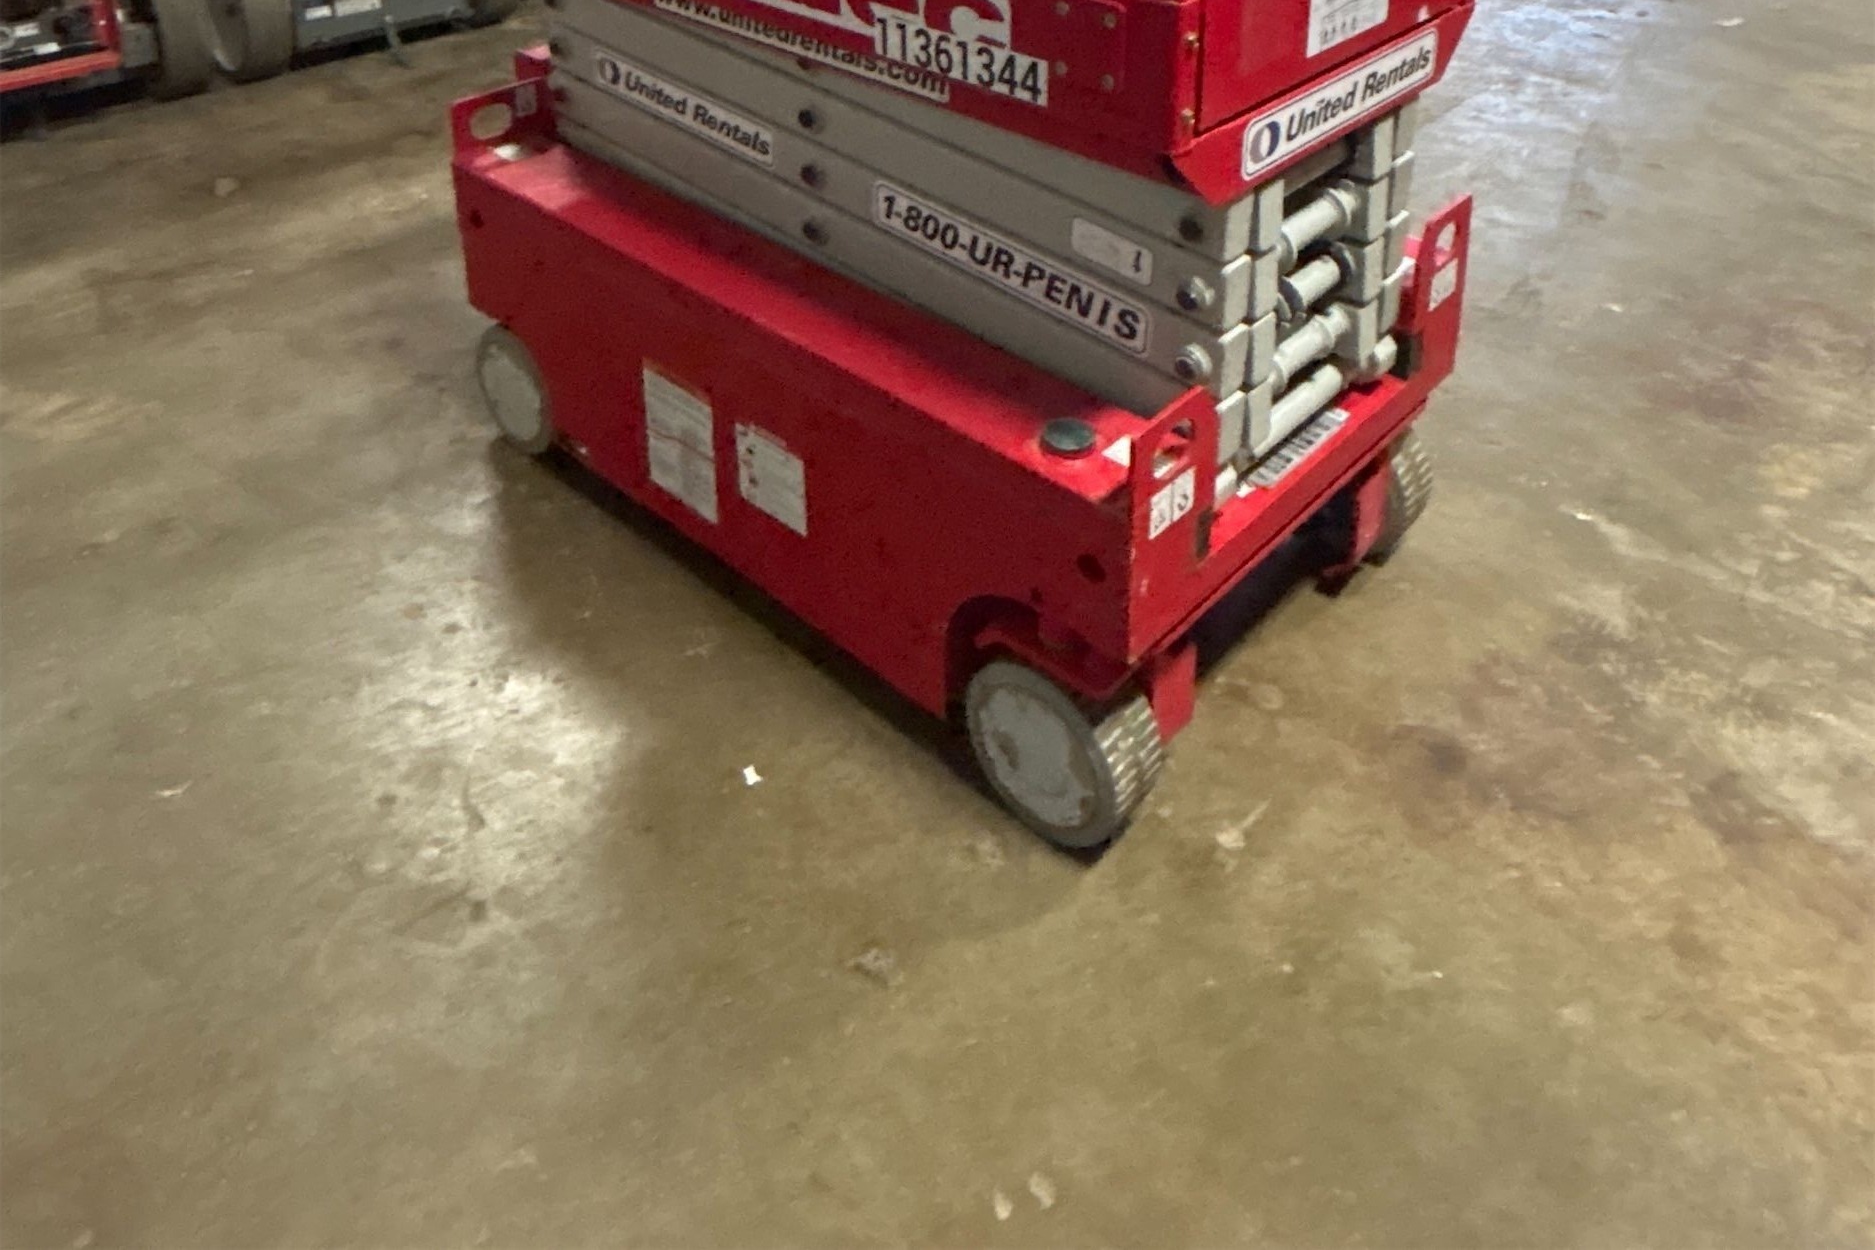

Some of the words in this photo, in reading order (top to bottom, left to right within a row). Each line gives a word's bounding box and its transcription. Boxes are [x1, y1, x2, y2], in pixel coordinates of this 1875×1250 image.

[876, 17, 1042, 102] 11361344
[1286, 82, 1359, 142] United
[1361, 46, 1431, 102] Rentals
[624, 71, 688, 115] United
[692, 103, 770, 155] Rentals
